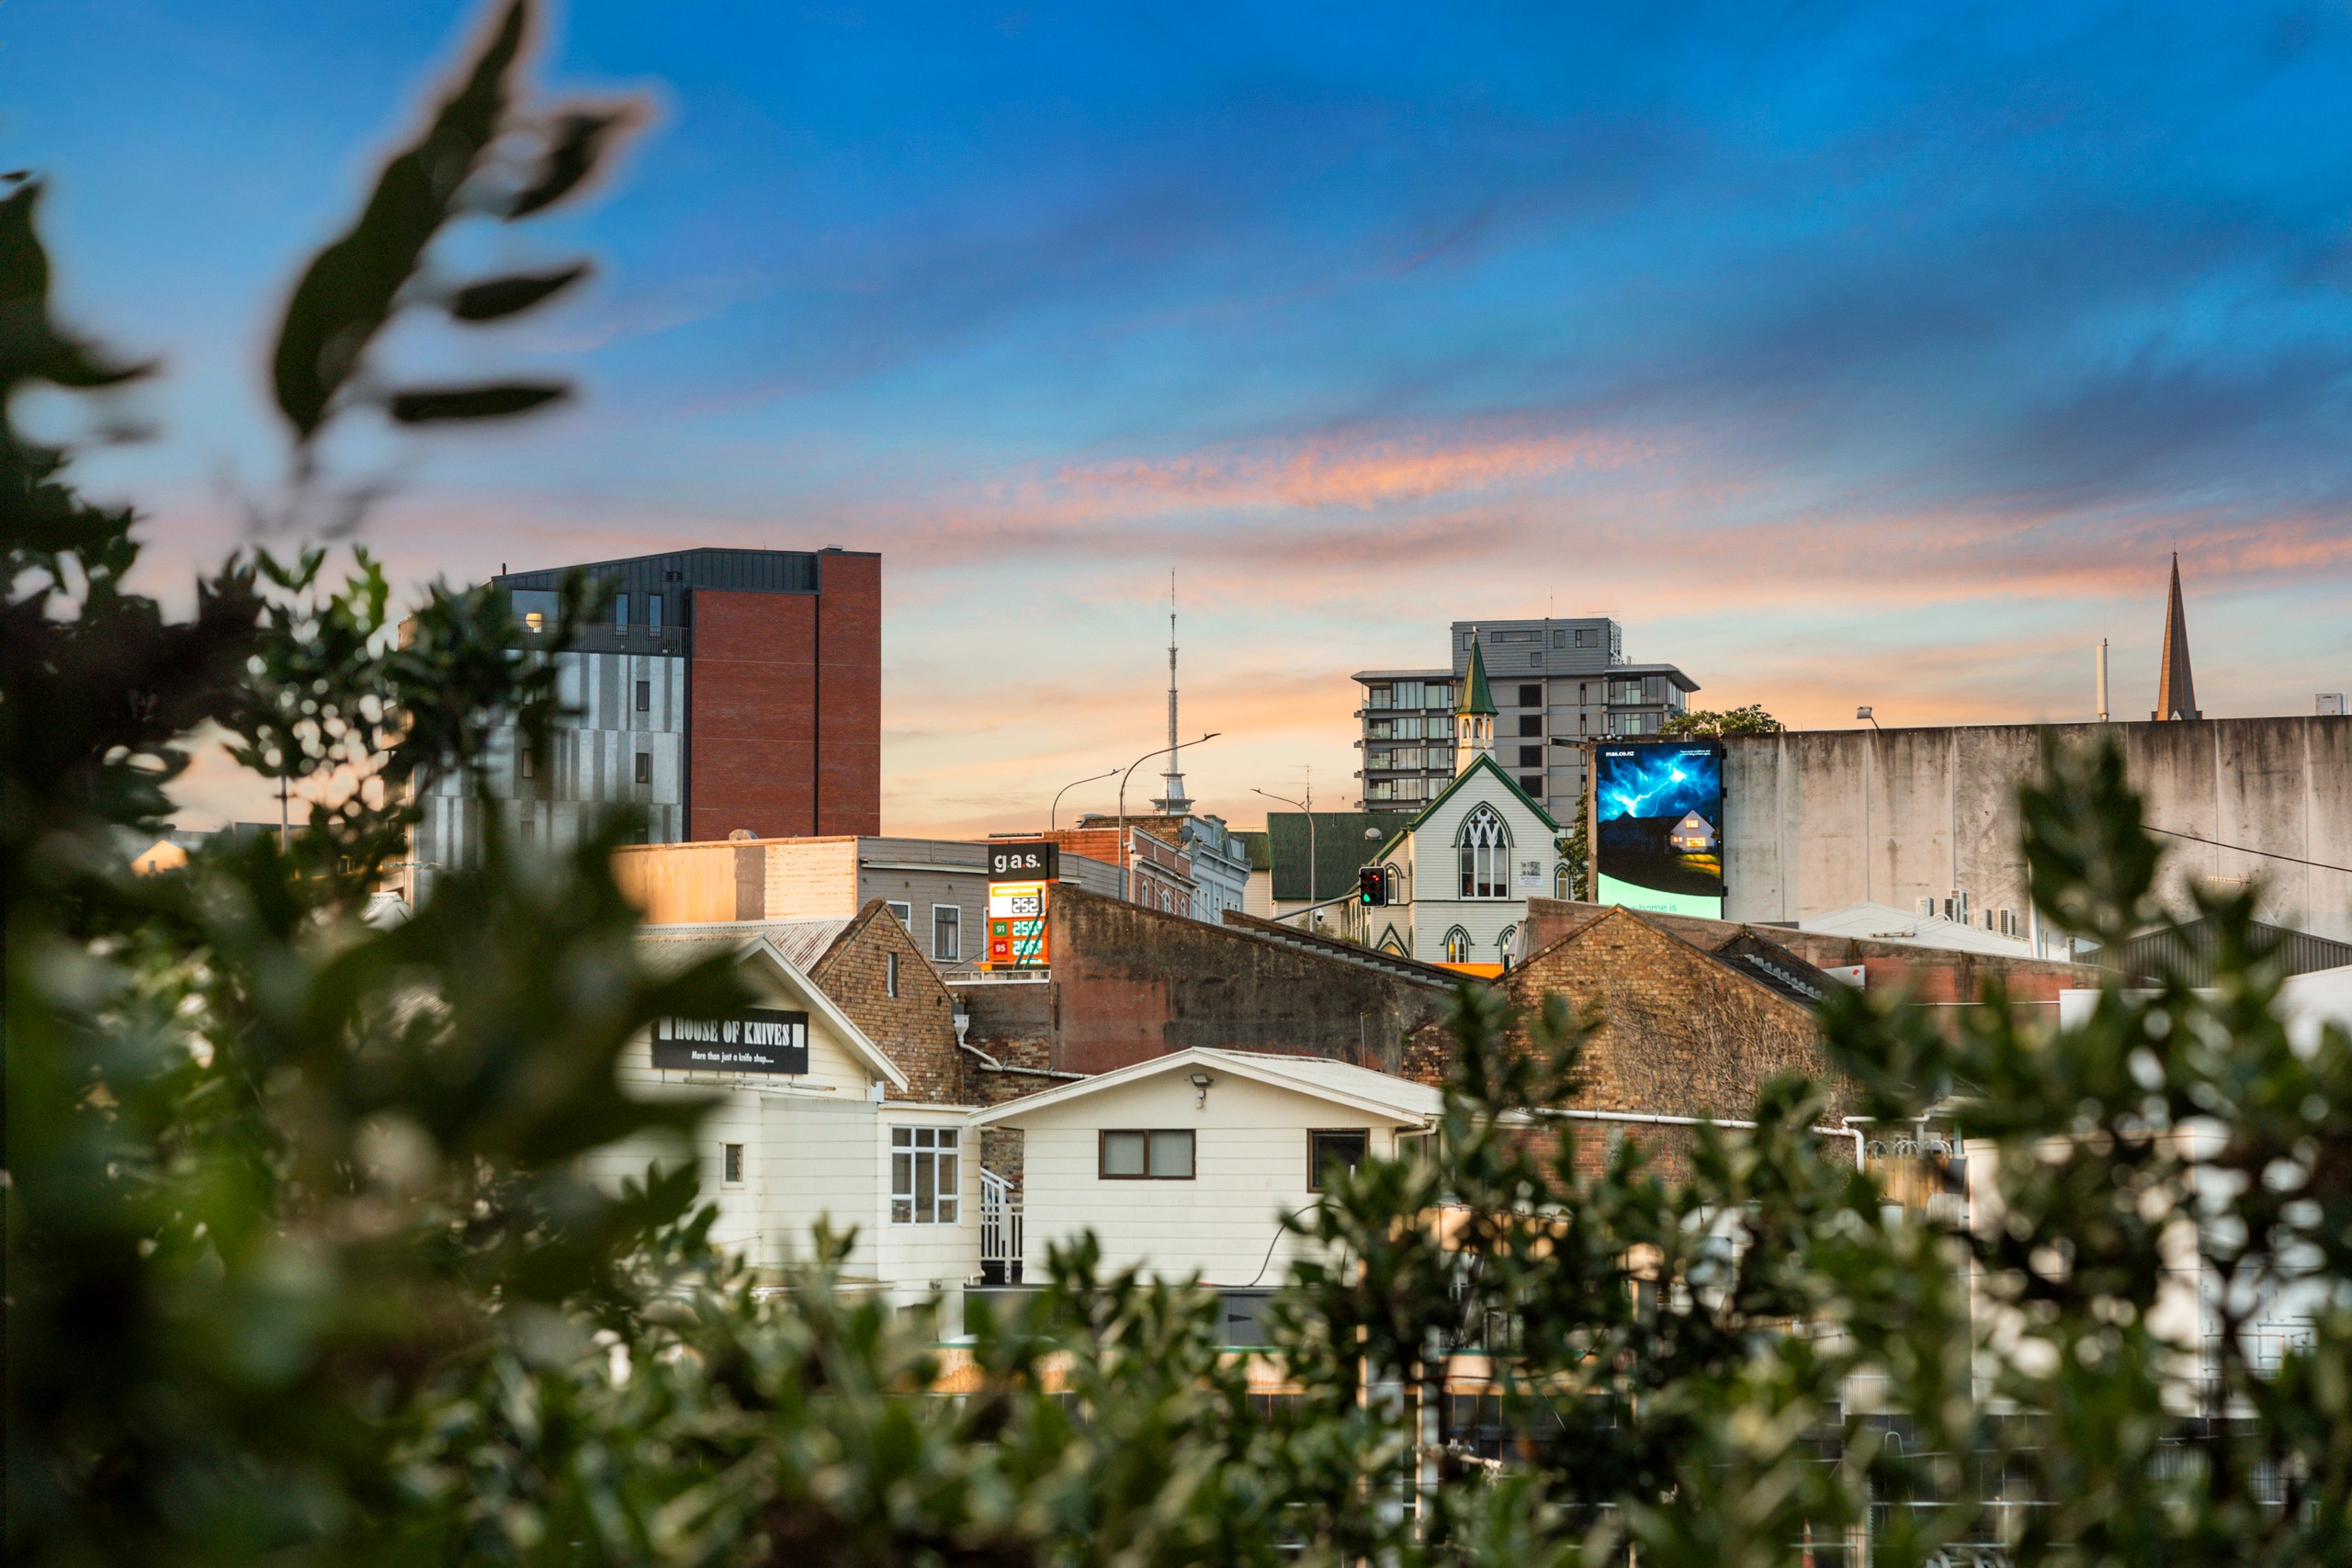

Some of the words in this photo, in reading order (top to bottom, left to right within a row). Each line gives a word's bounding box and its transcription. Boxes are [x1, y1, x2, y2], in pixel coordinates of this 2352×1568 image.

[996, 925, 1005, 933] 91
[995, 943, 1006, 953] 95
[674, 1016, 718, 1043] HOUSE
[723, 1020, 741, 1043] OF
[744, 1021, 790, 1046] KNIVES
[691, 1050, 707, 1061] More
[707, 1051, 720, 1061] than
[720, 1051, 732, 1063] just
[738, 1052, 752, 1063] knife
